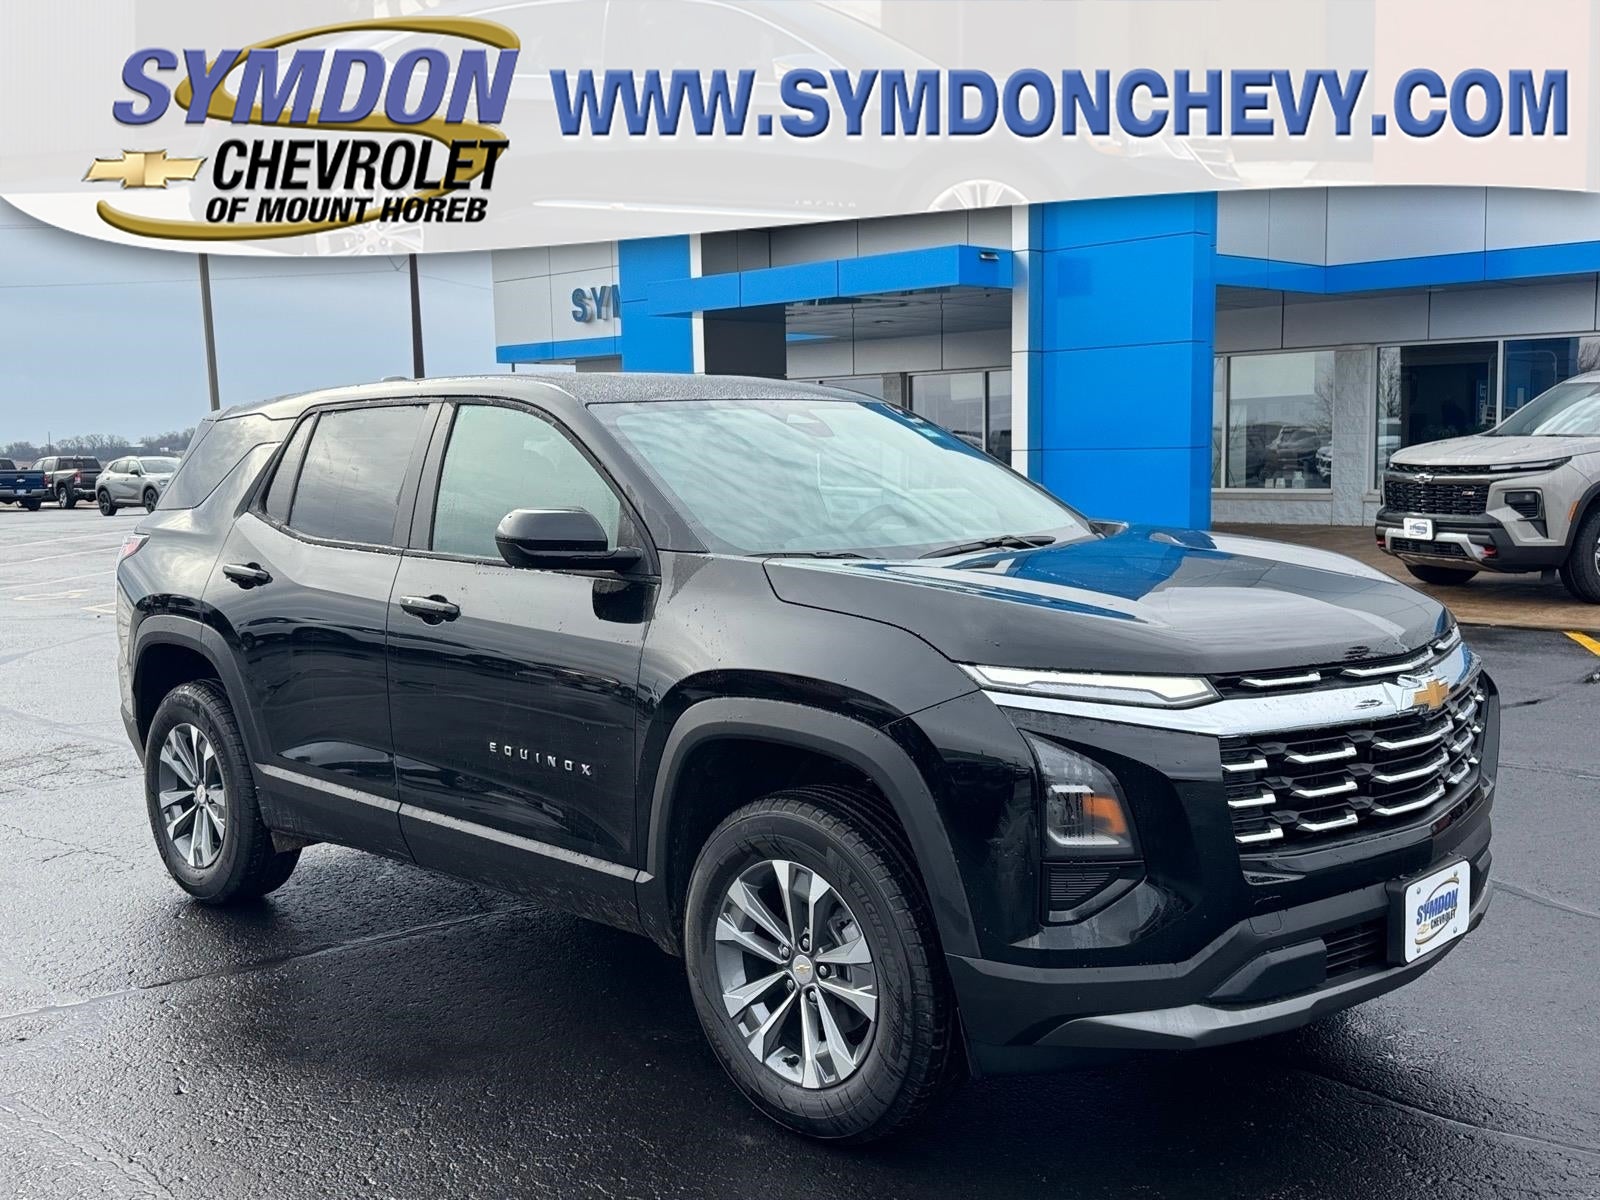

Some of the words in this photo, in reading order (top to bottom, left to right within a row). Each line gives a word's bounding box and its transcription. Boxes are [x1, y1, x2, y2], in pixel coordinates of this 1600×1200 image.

[489, 741, 593, 776] EQUINOX
[1416, 887, 1459, 926] SYMDON
[1430, 908, 1456, 930] CHEVROLET
